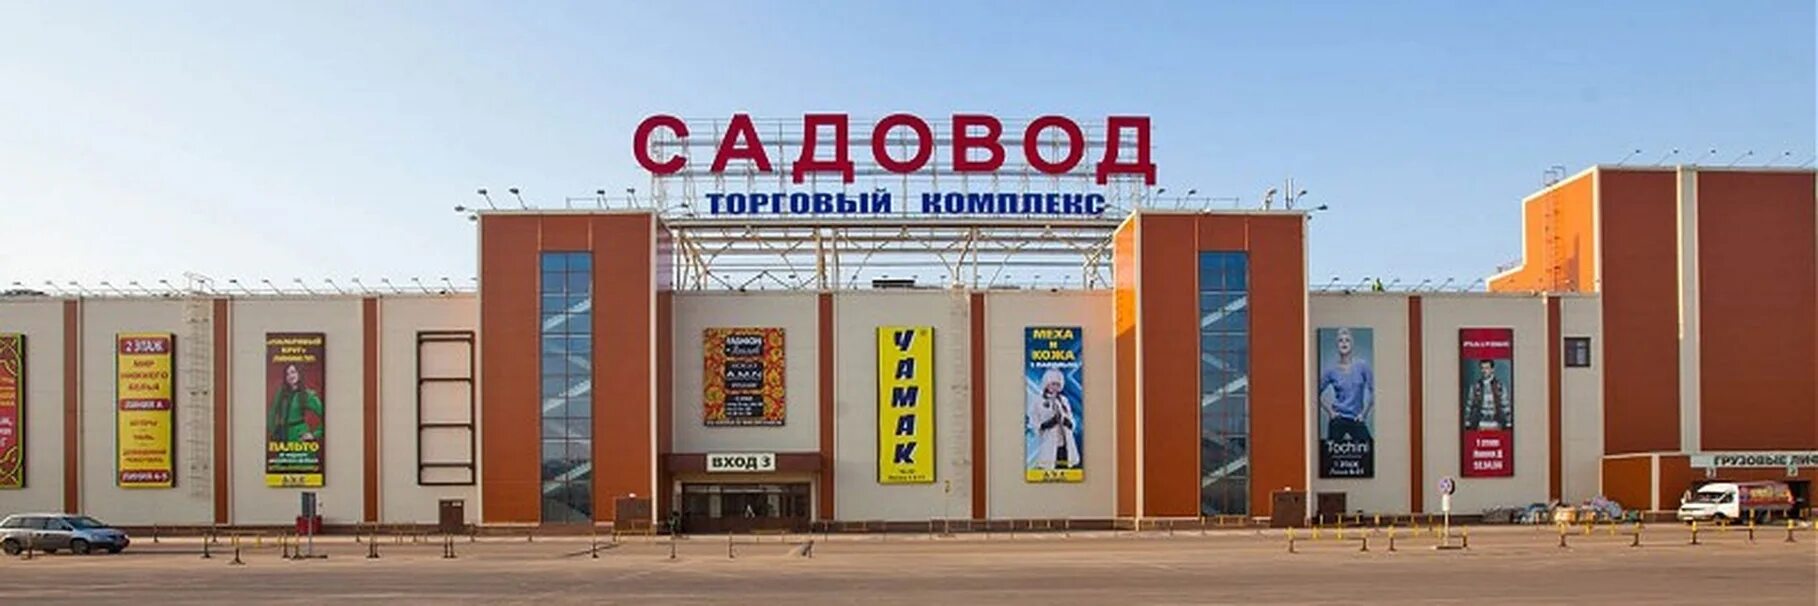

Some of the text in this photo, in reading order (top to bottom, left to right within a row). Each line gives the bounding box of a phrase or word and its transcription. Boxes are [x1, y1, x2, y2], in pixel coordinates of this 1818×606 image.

[633, 113, 1156, 186] САДОВОД
[706, 187, 1106, 215] ТОРГОВЫЙ КОМПЛЕКС
[1032, 329, 1074, 340] МЕХА
[124, 340, 165, 352] 2 ЭТАЖ
[1031, 350, 1076, 361] КОЖА
[268, 441, 321, 452] ПАЛЬТО
[1325, 440, 1370, 454] Tochini
[712, 456, 771, 470] ВХОД 3
[1714, 455, 1787, 465] ГРУЗОВЫЕ
